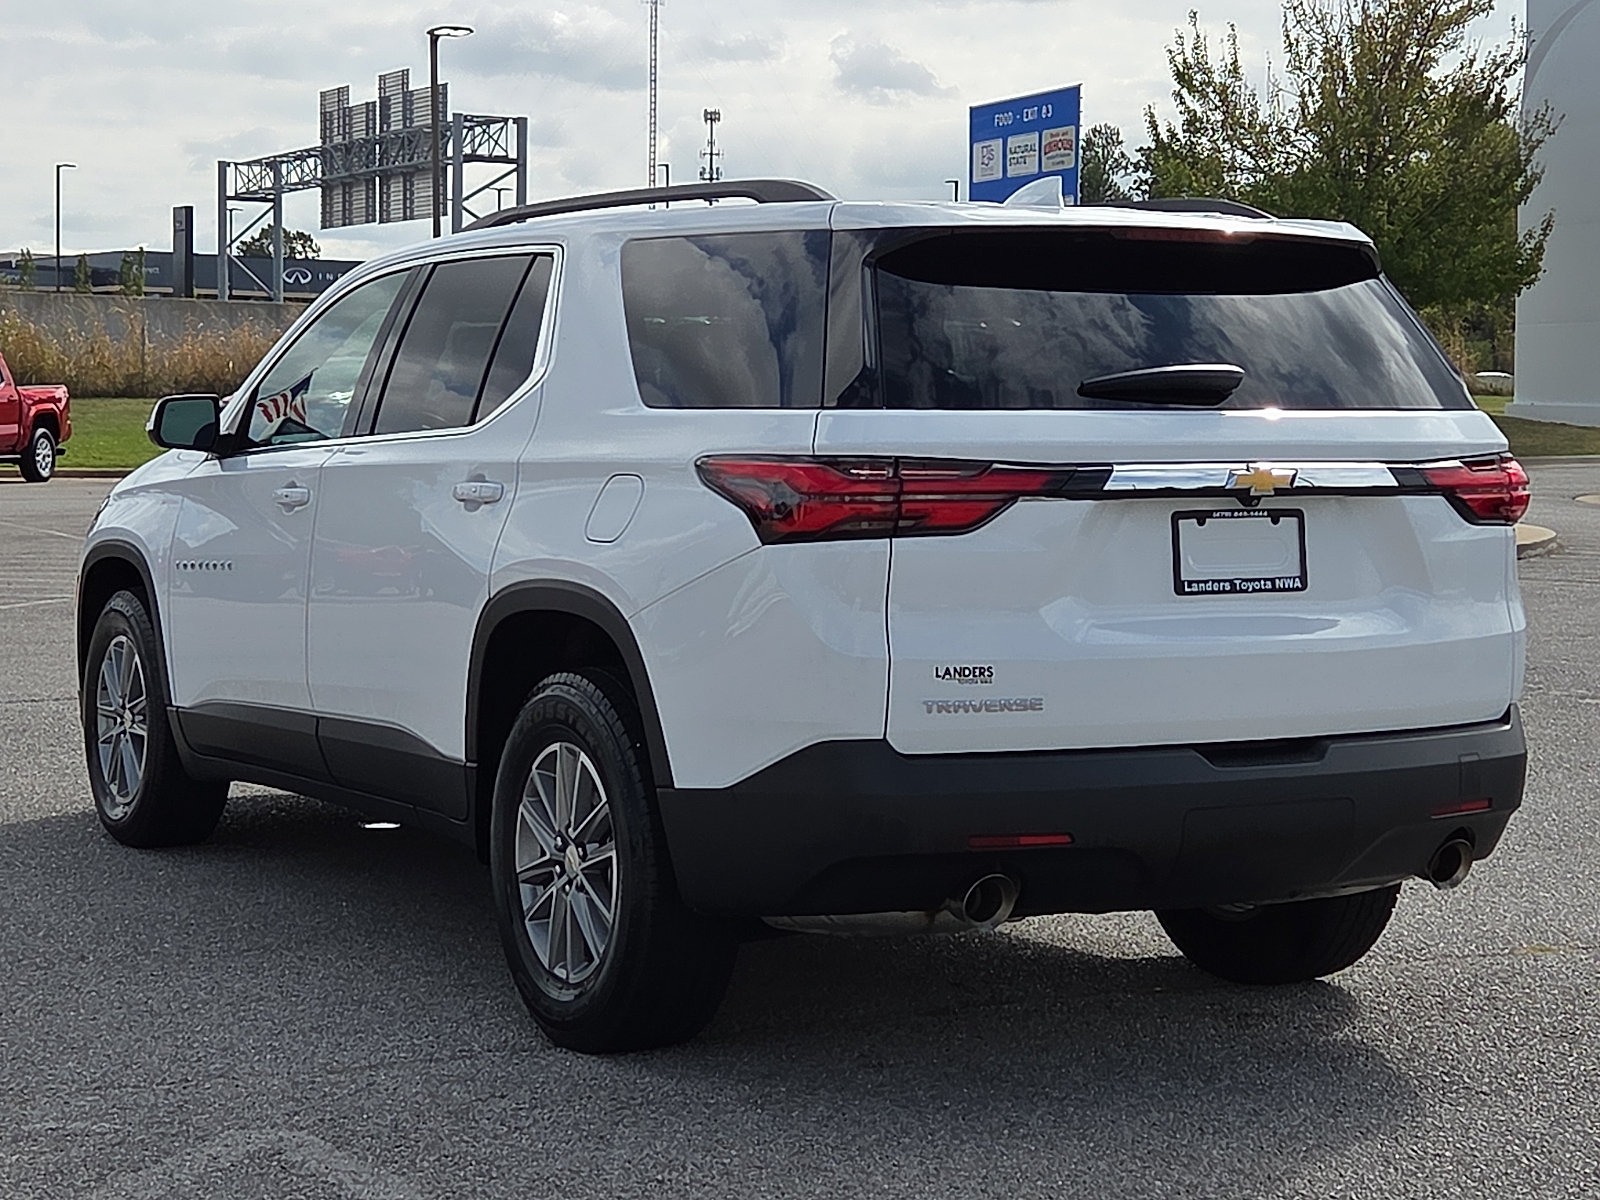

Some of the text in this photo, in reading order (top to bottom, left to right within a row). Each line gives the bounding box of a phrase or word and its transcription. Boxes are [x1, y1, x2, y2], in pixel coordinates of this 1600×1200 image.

[994, 111, 1014, 127] FOOD
[1023, 106, 1039, 121] EXIT
[1008, 143, 1037, 155] NATURAL
[1008, 155, 1028, 167] STATE
[1184, 578, 1302, 592] Landers Toyota NWA
[935, 666, 994, 680] LANDERS
[922, 698, 1043, 714] TRAVERSE
